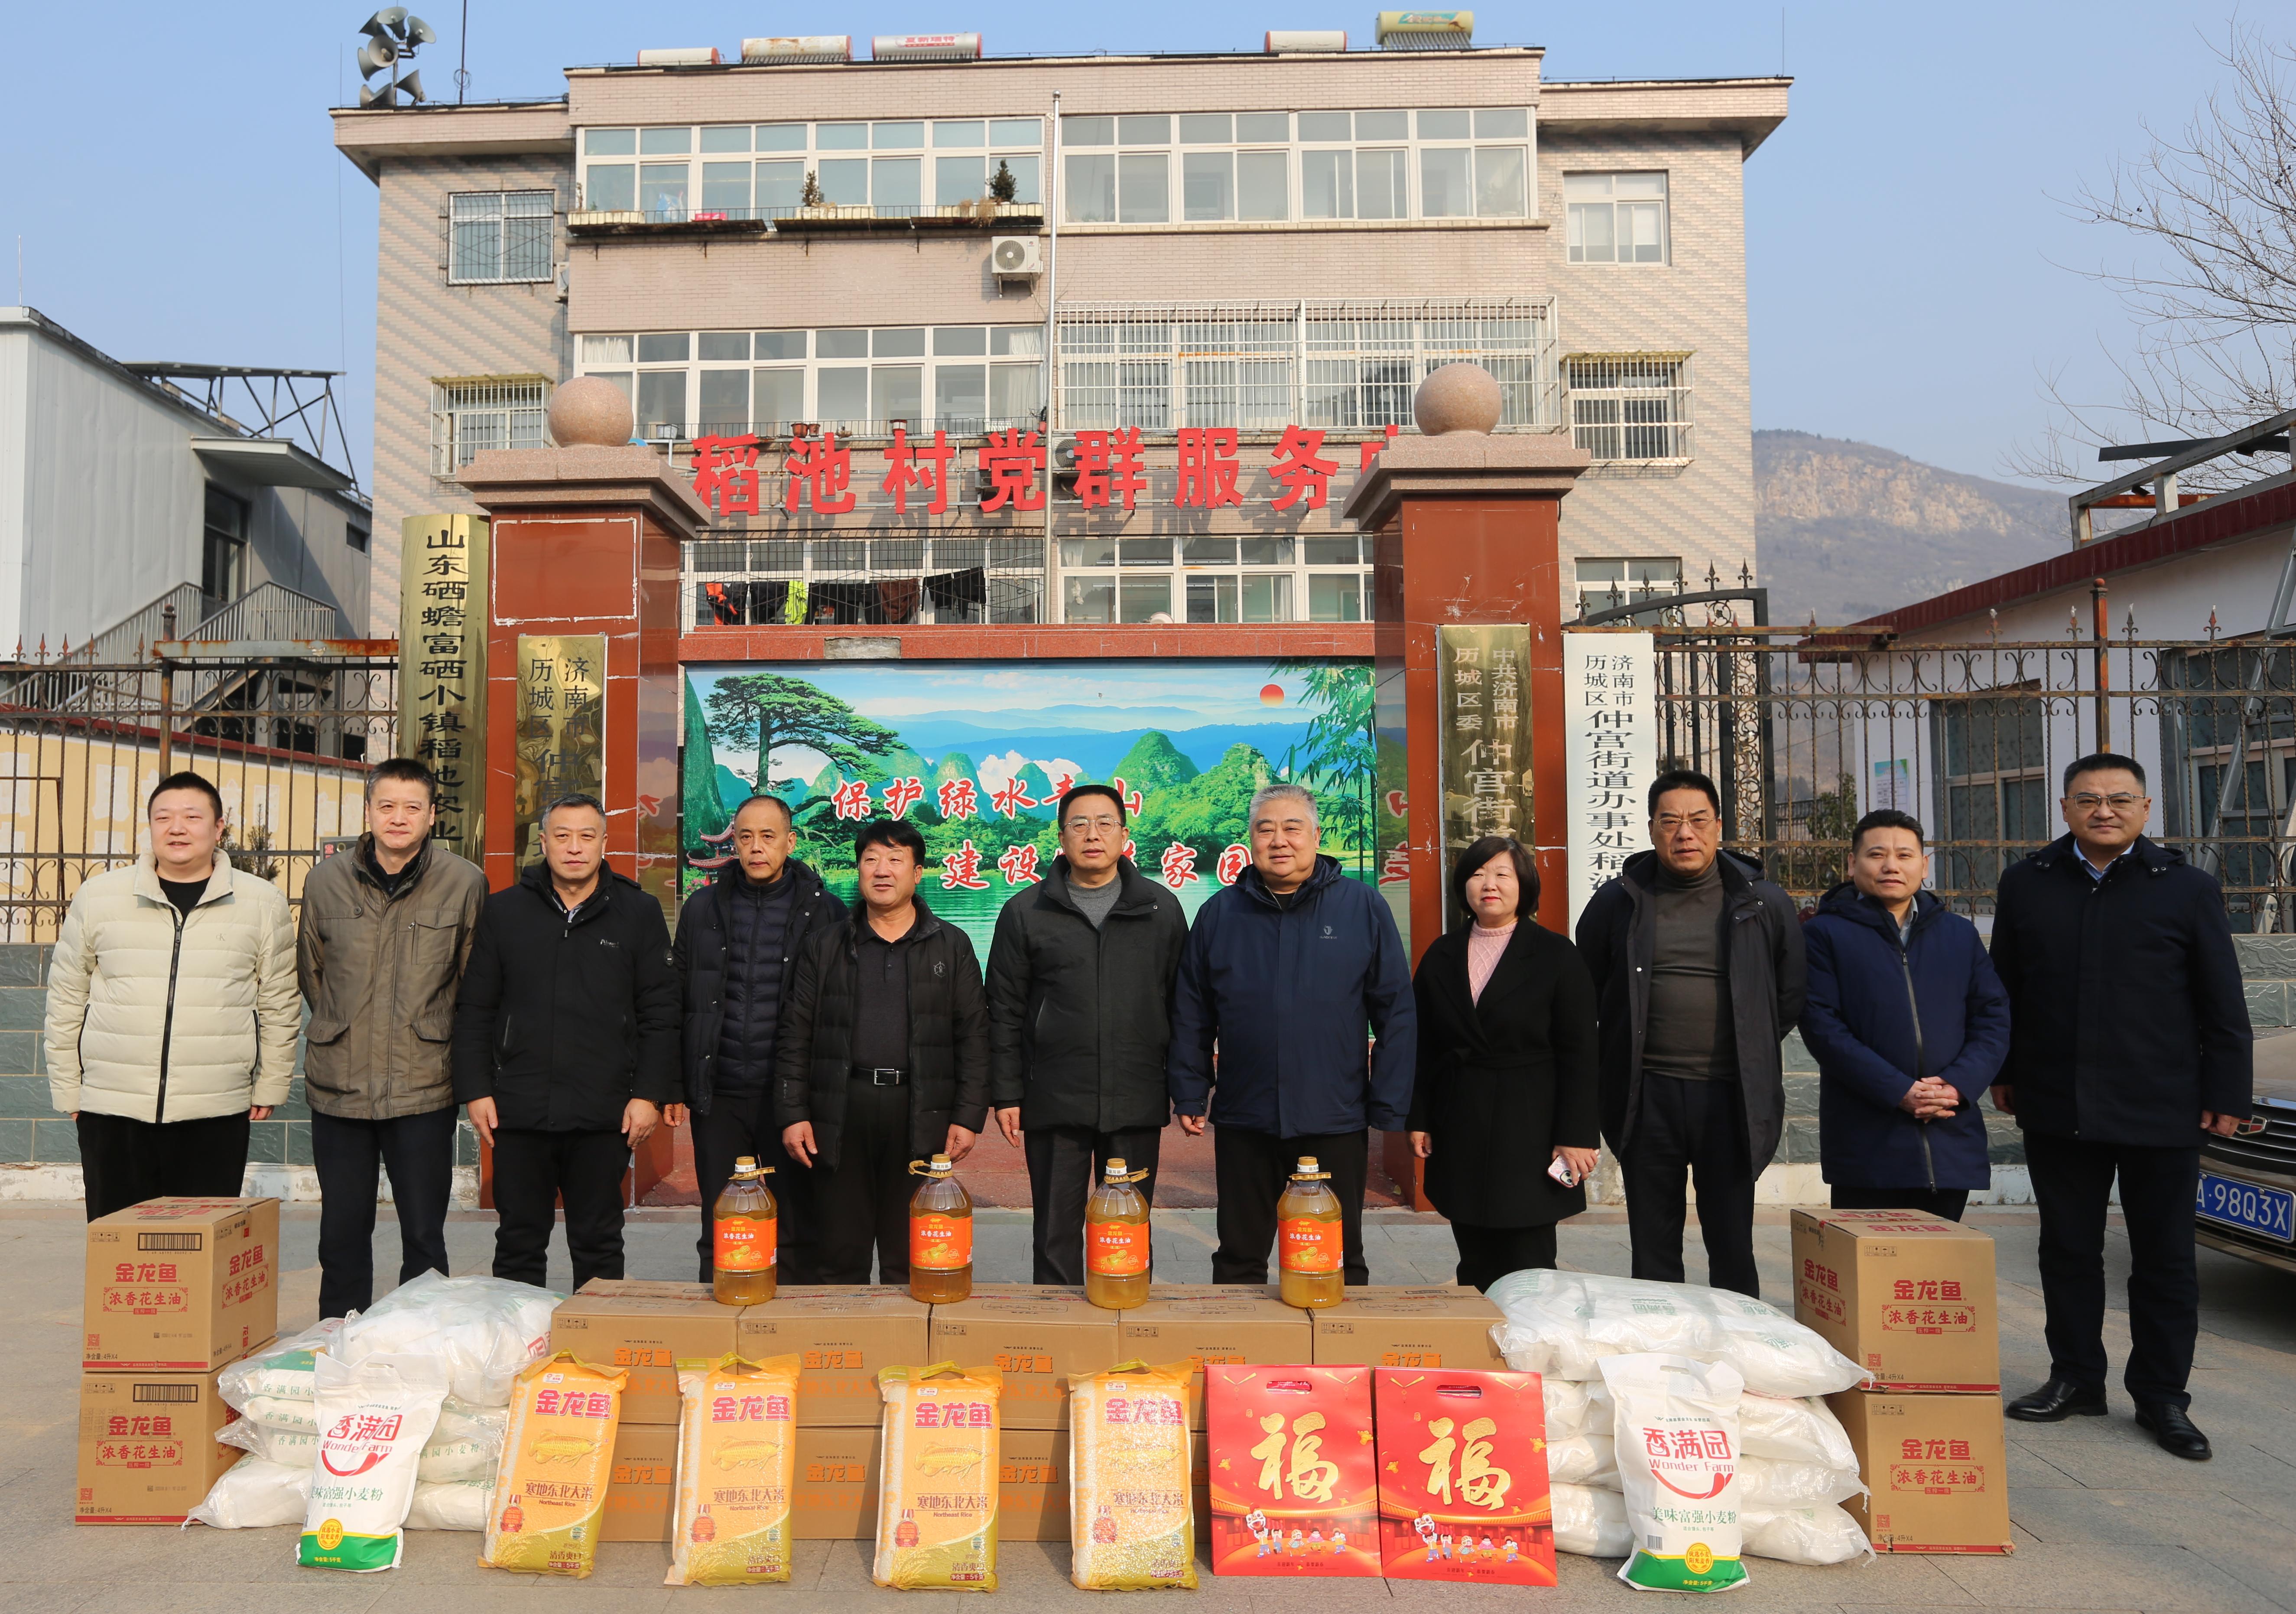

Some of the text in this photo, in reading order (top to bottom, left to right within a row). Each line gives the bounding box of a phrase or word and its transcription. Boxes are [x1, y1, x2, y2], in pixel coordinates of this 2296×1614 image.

[418, 529, 469, 851] 山东硒蟾富硒小镇稻池农业
[1454, 647, 1482, 731] 历城区委
[1491, 648, 1519, 731] 中共济南市
[1584, 654, 1609, 706] 历城区
[1611, 654, 1635, 706] 济南市
[529, 659, 554, 739] 历城区
[563, 658, 589, 739] 济南市
[531, 748, 580, 858] 仲宫
[1584, 709, 1637, 898] 仲宫街道办事处稻
[939, 838, 1252, 890] 建设家园
[115, 1263, 177, 1282] 金龙鱼
[229, 1244, 263, 1276] 金龙鱼
[225, 1270, 265, 1300] 浓香花生油
[1804, 1258, 1838, 1292] 金龙鱼
[109, 1292, 181, 1306] 浓香花生油
[1802, 1286, 1842, 1317] 浓香花生油
[1894, 1280, 1962, 1301] 金龙鱼
[1889, 1309, 1968, 1325] 浓香花生油
[614, 1347, 672, 1367] 金龙鱼
[804, 1350, 863, 1369] 金龙鱼
[994, 1354, 1053, 1373] 金龙鱼
[1381, 1352, 1441, 1368] 金龙鱼
[536, 1389, 611, 1419] 金龙鱼
[712, 1394, 790, 1422] 金龙鱼
[915, 1402, 992, 1428] 金龙鱼
[1106, 1398, 1183, 1425] 金龙鱼
[109, 1416, 171, 1435] 金龙鱼
[327, 1413, 403, 1442] 香满园
[102, 1445, 176, 1460] 浓香花生油
[323, 1440, 393, 1453] Wonde Farm
[1250, 1411, 1339, 1503] 福
[1643, 1428, 1732, 1460] 香满园
[1902, 1439, 1971, 1460] 金龙鱼
[614, 1465, 672, 1484] 金龙鱼
[806, 1463, 866, 1482] 金龙鱼
[999, 1465, 1059, 1484] 金龙鱼
[1419, 1417, 1511, 1510] 福
[1649, 1458, 1734, 1472] Wonder Farm
[1897, 1469, 1977, 1485] 浓香花生油
[525, 1482, 593, 1499] 寒地东北大米
[714, 1488, 784, 1503] 寒地东北大米
[917, 1496, 988, 1509] 寒地东北大米
[1651, 1507, 1737, 1524] 美味富强小麦粉
